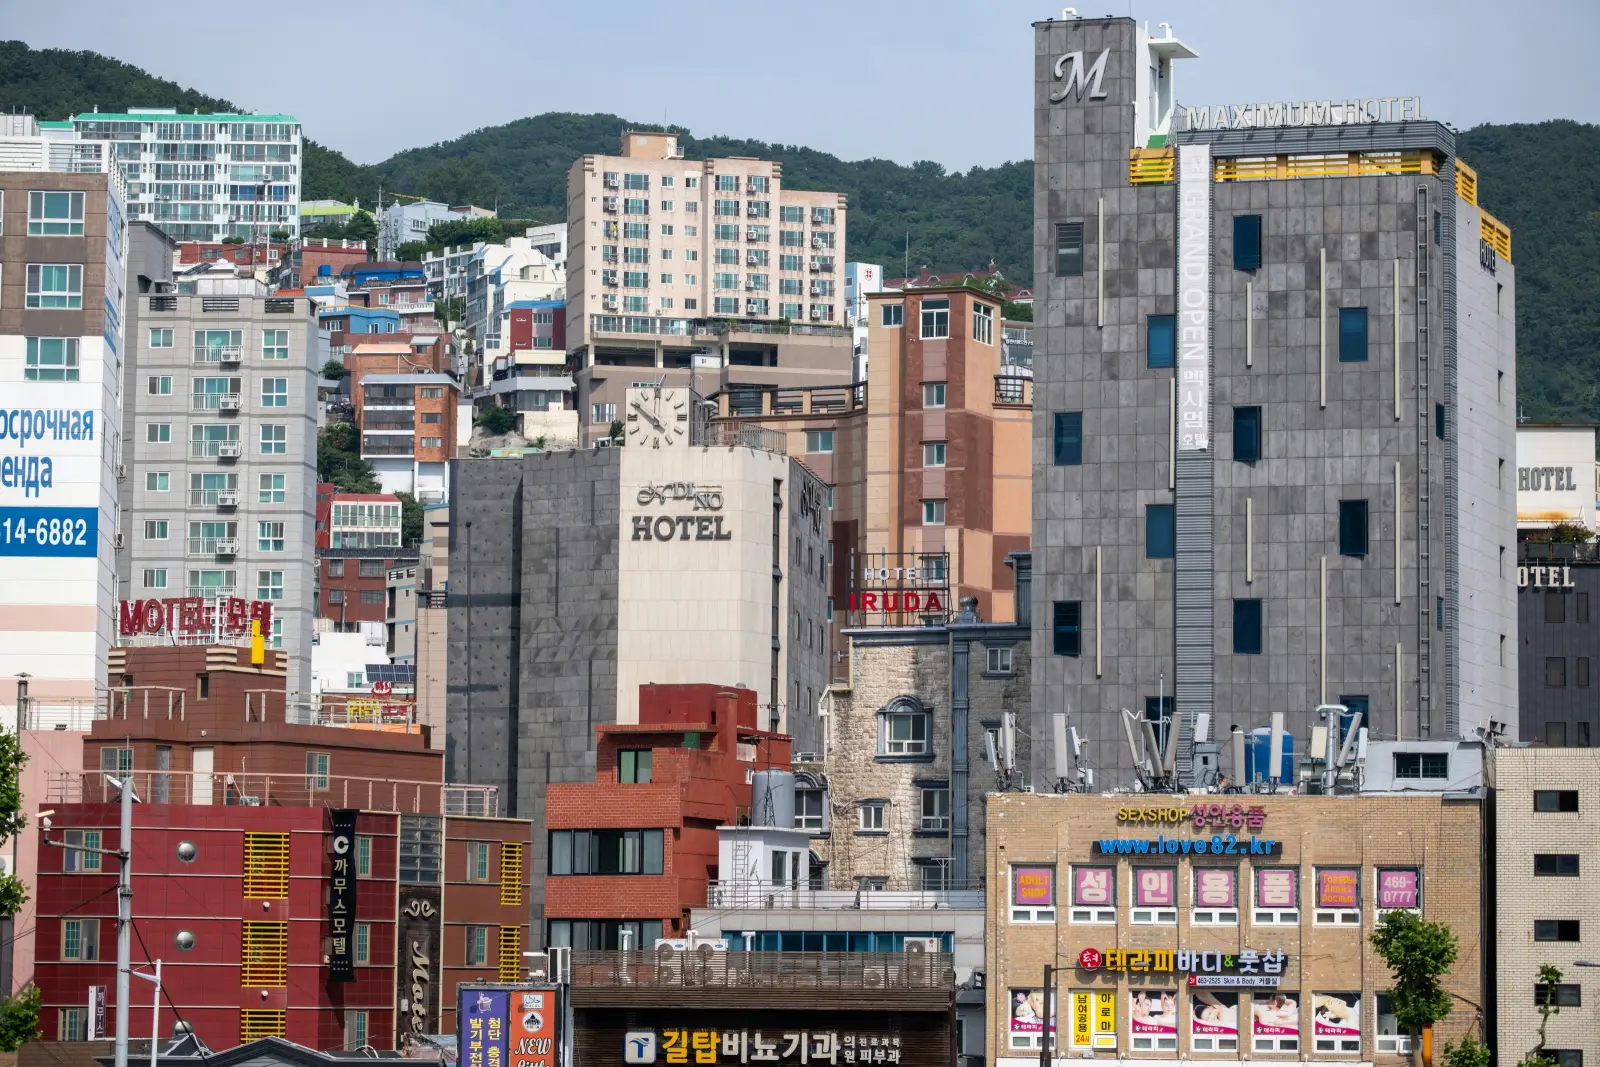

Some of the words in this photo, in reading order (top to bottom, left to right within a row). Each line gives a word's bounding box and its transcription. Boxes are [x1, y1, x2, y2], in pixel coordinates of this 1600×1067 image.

[1050, 47, 1110, 102] M
[1187, 101, 1331, 131] MAXIMUM
[1342, 96, 1427, 124] HOTEL
[1183, 186, 1206, 280] GRAND
[1183, 288, 1205, 360] OPEN
[1183, 370, 1204, 428] 맥시멈
[0, 456, 52, 498] енда
[1518, 466, 1577, 491] HOTEL
[0, 517, 87, 545] 14-6882
[631, 515, 732, 541] HOTEL
[864, 567, 929, 581] HOTEL
[849, 592, 943, 613] IRUDA
[119, 597, 216, 637] MOTEL
[1190, 804, 1265, 828] 성인용품
[1100, 835, 1275, 854] www.love82.kr
[1019, 875, 1049, 885] ADULT
[1384, 876, 1412, 888] 469-
[1021, 887, 1047, 898] SHOP
[1383, 891, 1412, 903] 0777
[1197, 977, 1221, 985] 463-2525
[1223, 977, 1235, 985] Skin
[1242, 977, 1256, 986] Body
[1101, 993, 1112, 1031] 아로마
[469, 1017, 483, 1067] 발기부전
[514, 1037, 552, 1055] NEW
[1075, 1034, 1090, 1043] 24시
[860, 1048, 901, 1065] 피부과
